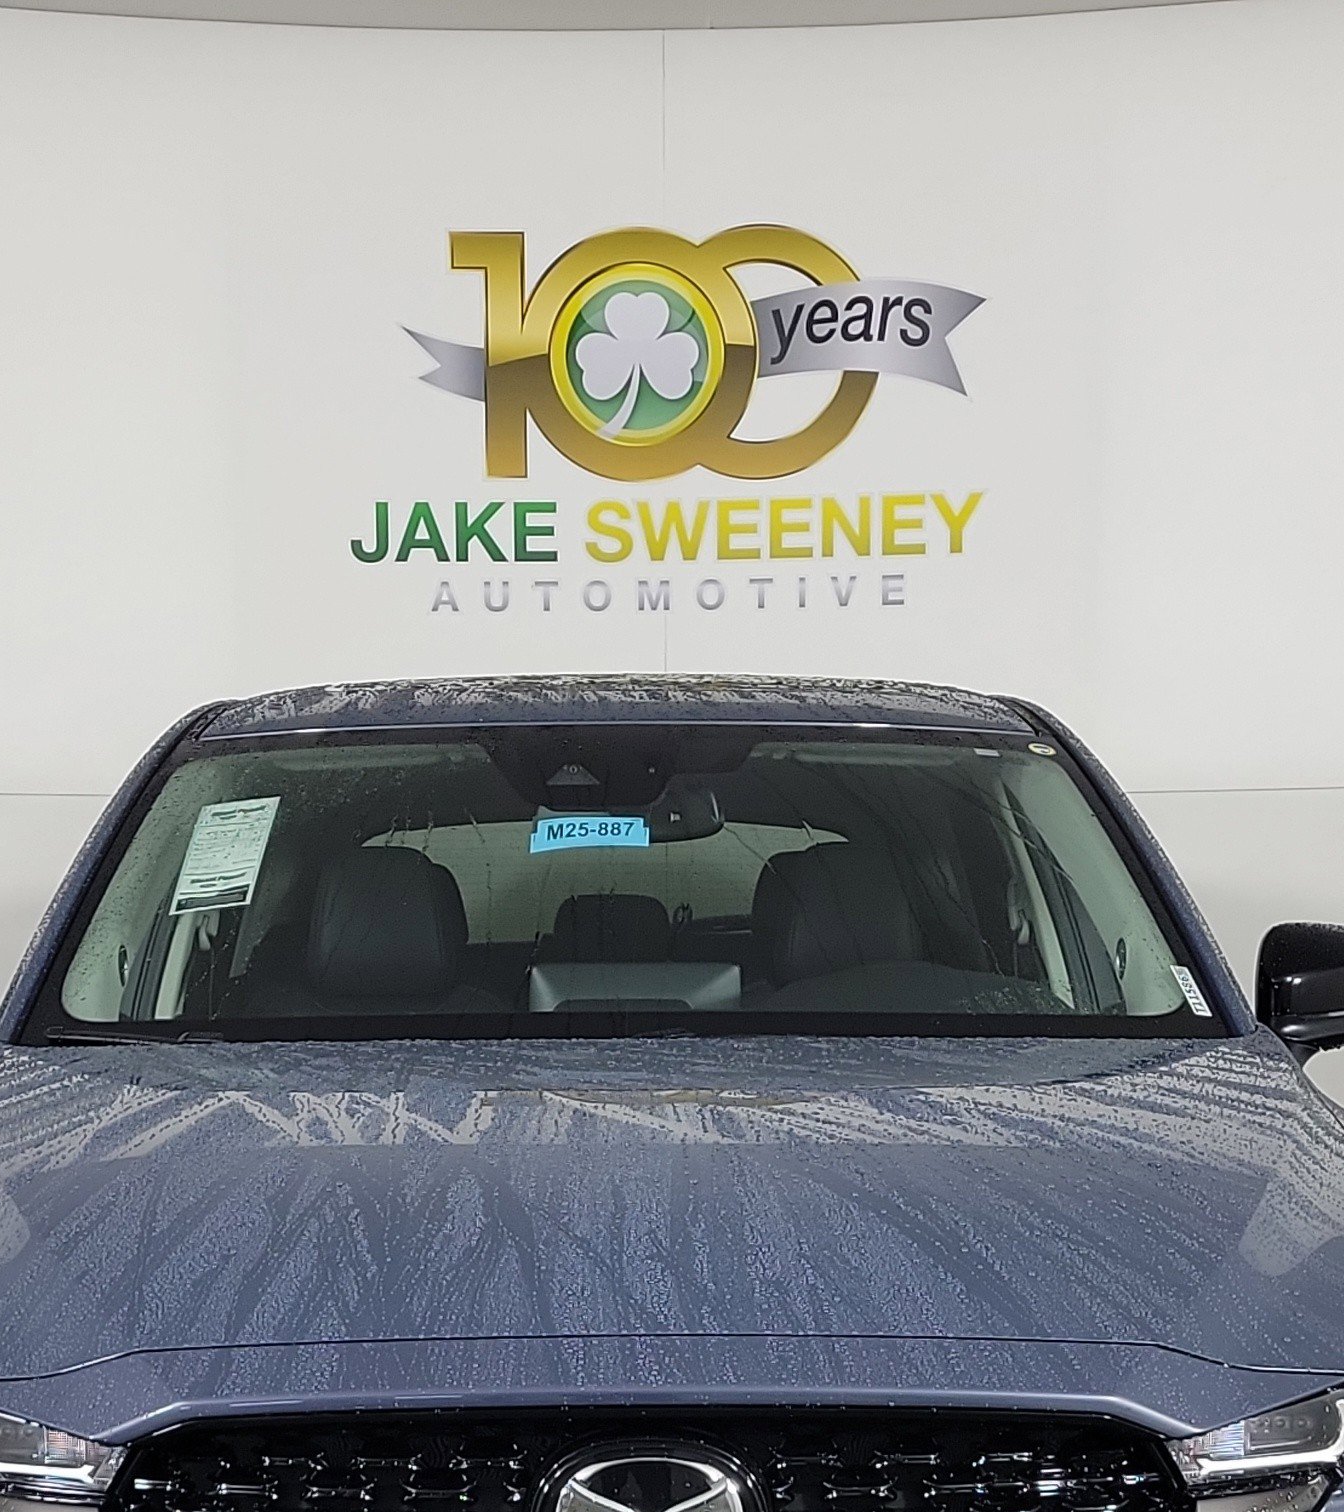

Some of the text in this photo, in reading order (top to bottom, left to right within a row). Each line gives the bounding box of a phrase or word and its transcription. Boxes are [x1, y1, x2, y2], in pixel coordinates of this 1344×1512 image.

[448, 222, 933, 482] 100 years
[350, 491, 985, 564] JAKE SWEENEY
[431, 573, 907, 613] AUTOMOTIVE
[546, 821, 635, 841] M25-887
